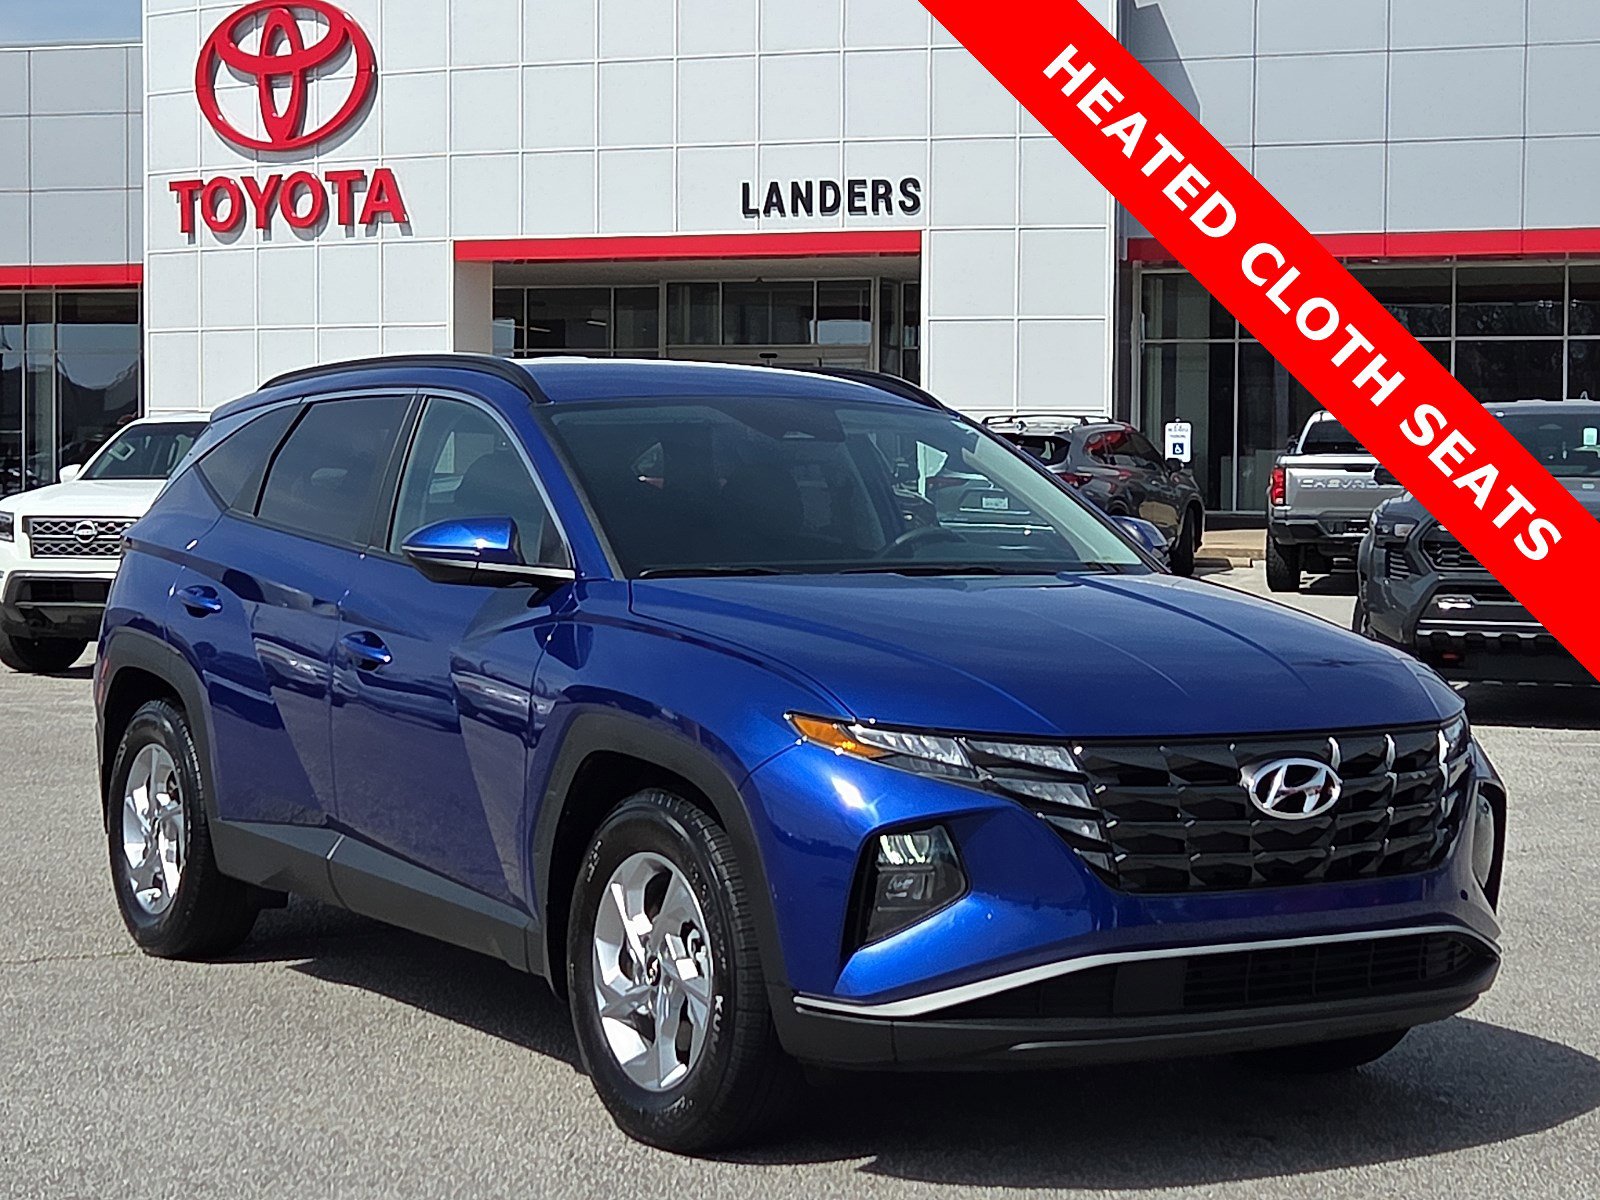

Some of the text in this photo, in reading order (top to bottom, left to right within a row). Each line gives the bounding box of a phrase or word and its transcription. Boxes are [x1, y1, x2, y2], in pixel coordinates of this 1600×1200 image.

[168, 167, 410, 234] TOYOTA
[741, 177, 922, 217] LANDERS
[1300, 479, 1380, 489] CHEVRO
